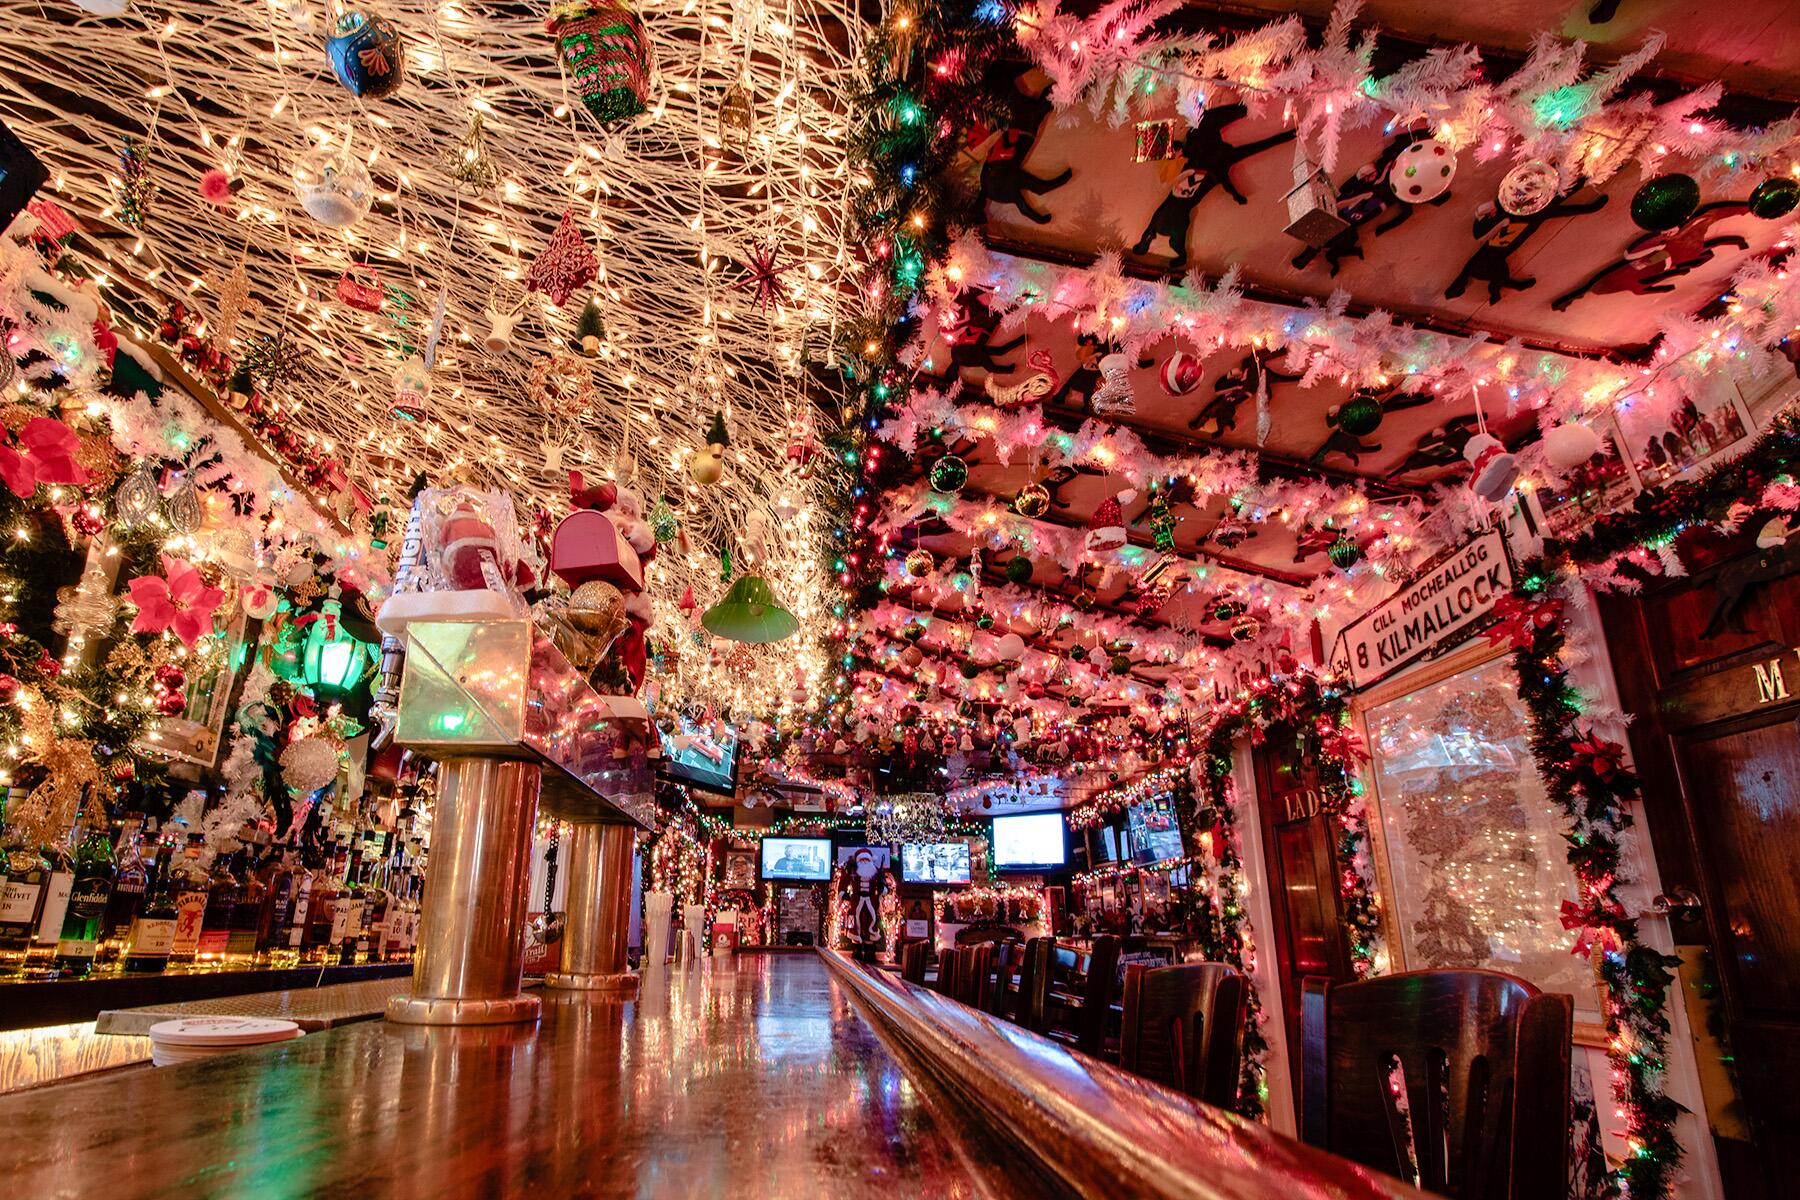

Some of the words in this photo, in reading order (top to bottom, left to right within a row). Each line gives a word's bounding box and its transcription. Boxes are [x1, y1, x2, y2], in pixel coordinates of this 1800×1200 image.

[1373, 611, 1396, 634] CILL
[1401, 544, 1488, 615] MOCHEALLÓG
[1760, 559, 1767, 568] 6
[1356, 641, 1369, 669] 8
[1376, 563, 1508, 667] KILMALLOCK
[1752, 647, 1800, 704] M
